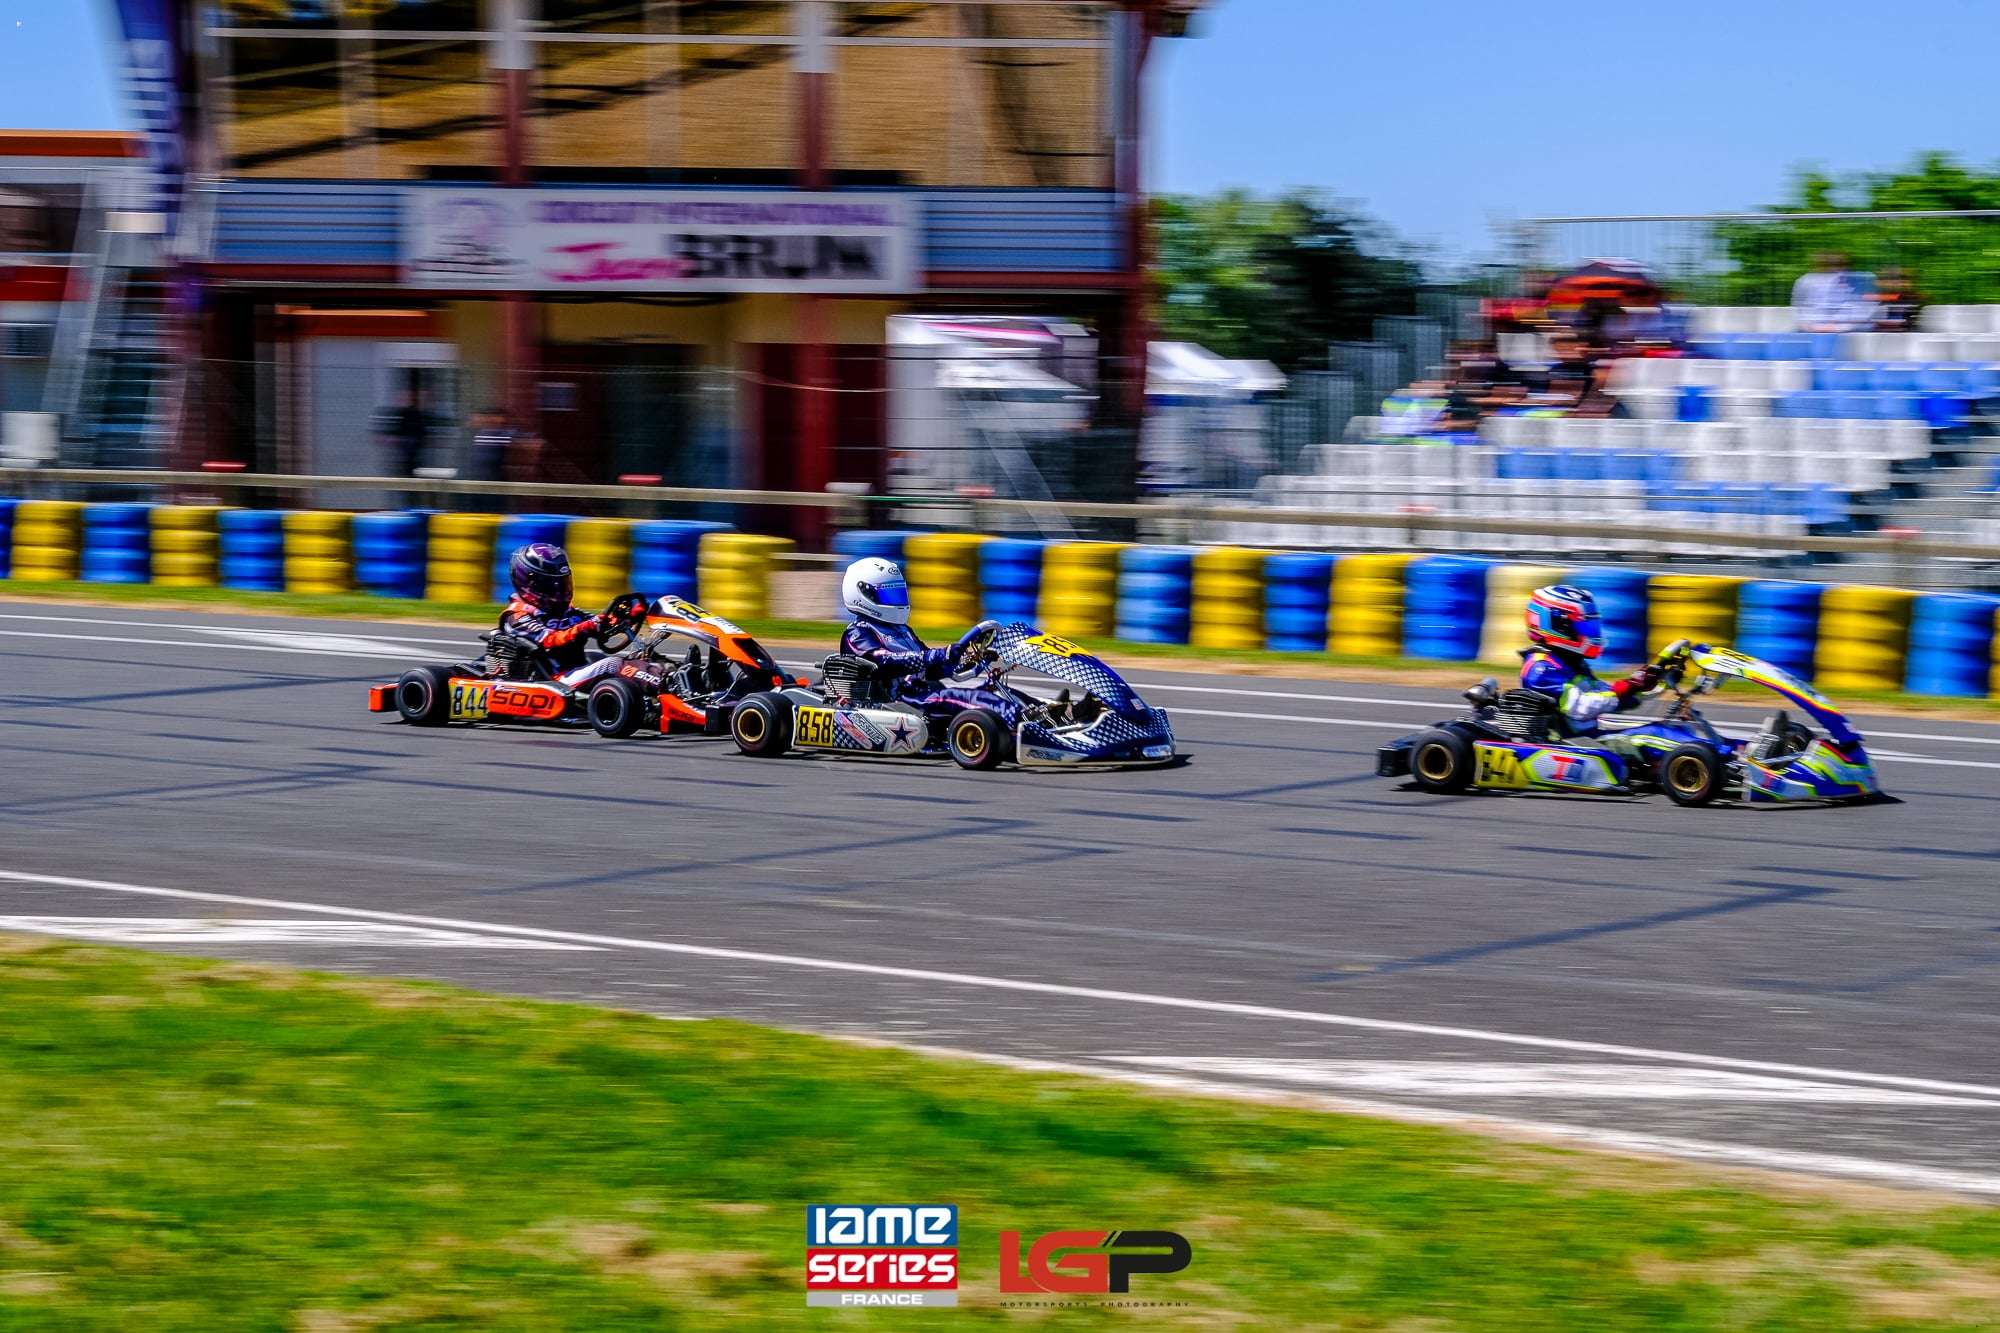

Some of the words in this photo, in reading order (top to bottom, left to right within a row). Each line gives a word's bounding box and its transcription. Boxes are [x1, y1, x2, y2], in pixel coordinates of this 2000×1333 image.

[453, 686, 488, 715] 844
[491, 689, 556, 710] SODI
[799, 711, 832, 743] 858
